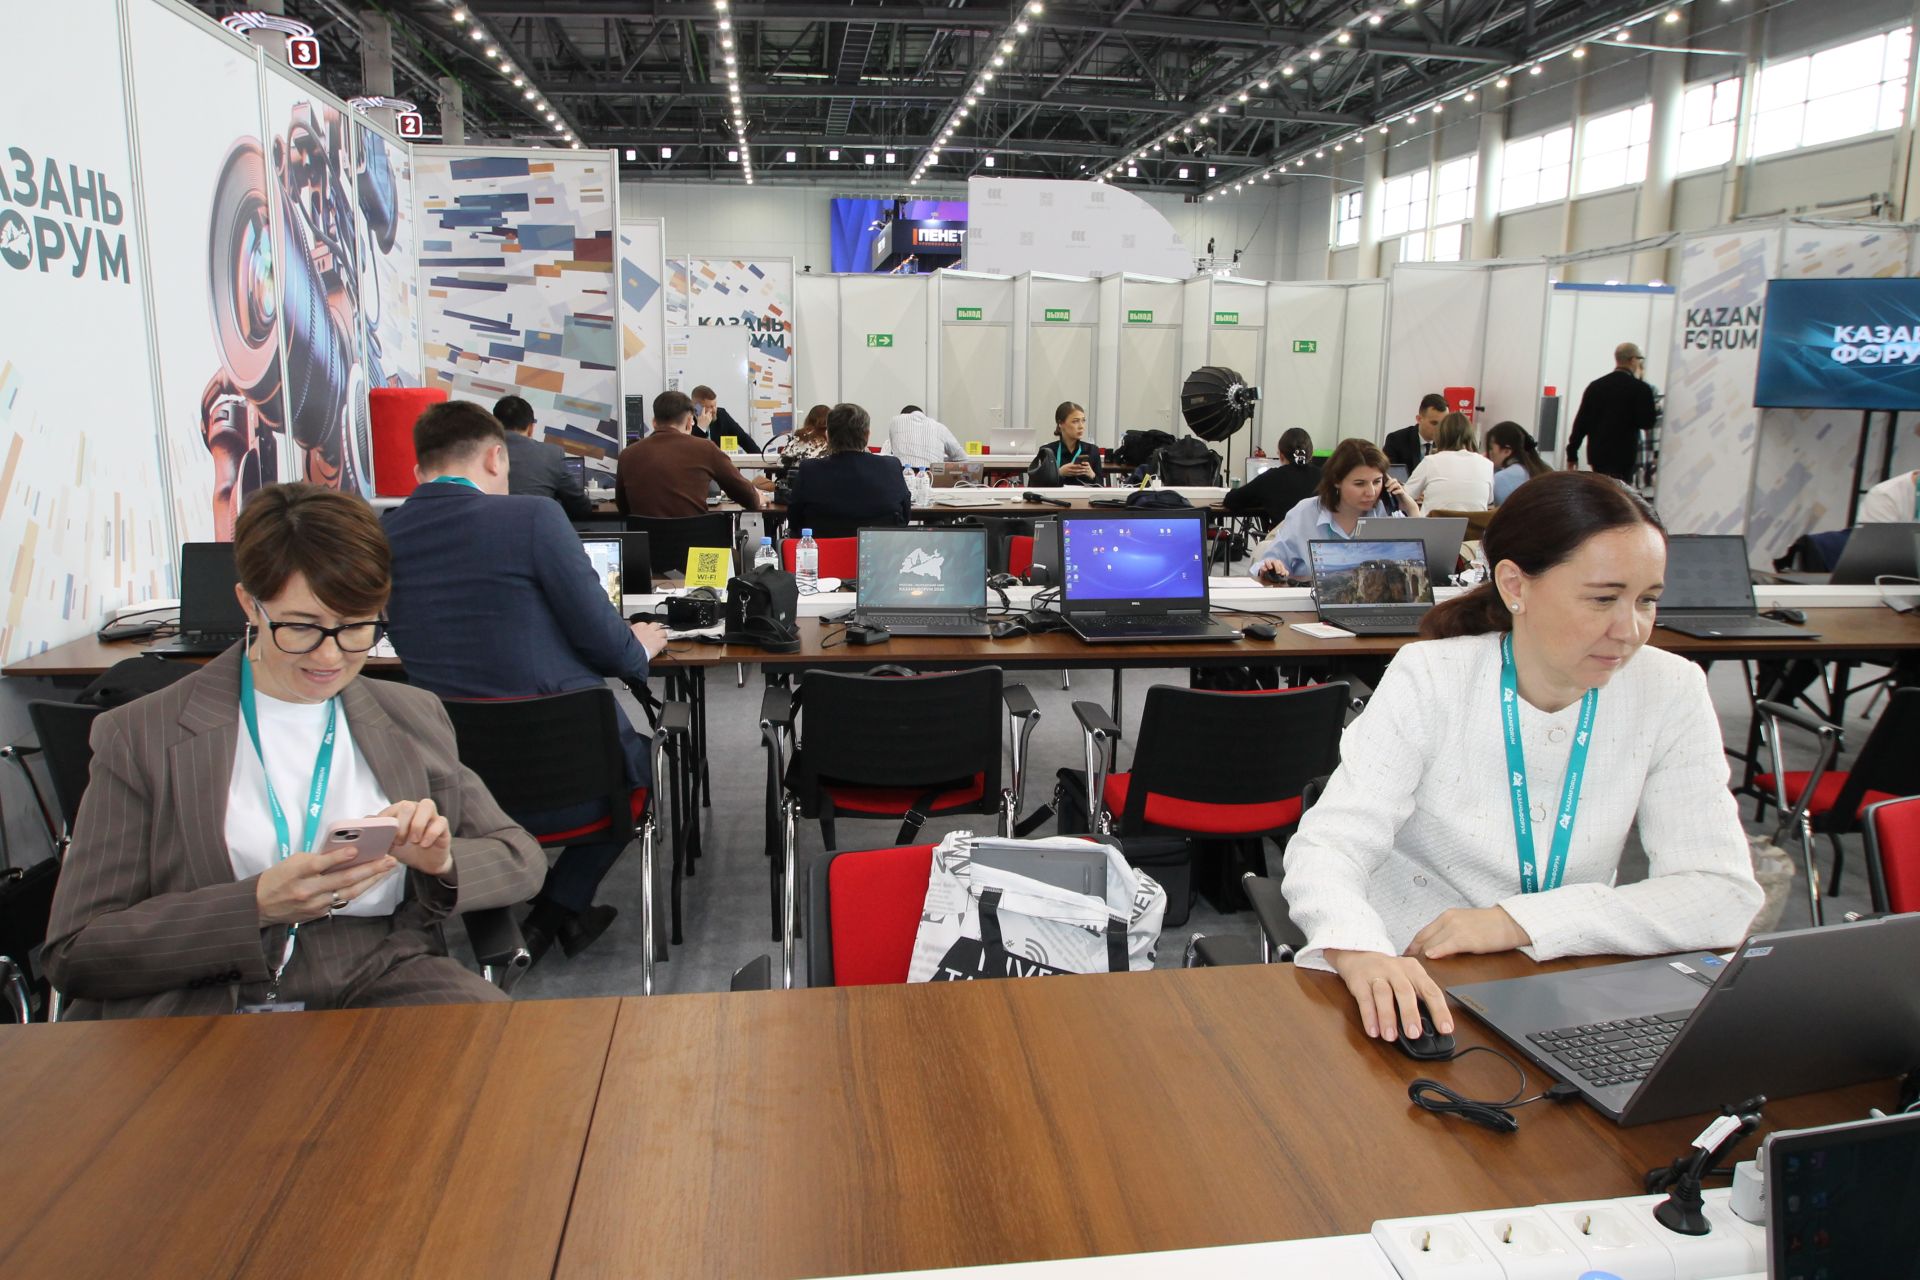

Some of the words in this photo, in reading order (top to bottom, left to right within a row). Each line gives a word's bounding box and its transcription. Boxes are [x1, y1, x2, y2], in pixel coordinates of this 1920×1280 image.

[298, 43, 311, 62] 3
[405, 117, 415, 132] 2
[958, 310, 981, 319] ВЫХОД
[1046, 311, 1069, 320] ВЫХОД
[1129, 312, 1152, 321] ВЫХОД
[1215, 314, 1238, 323] ВЫХОД
[1686, 306, 1762, 328] KAZAN
[1684, 329, 1758, 350] FORUM
[1507, 704, 1516, 745] KAZANFORUM
[1565, 772, 1577, 813] KAZANFORUM
